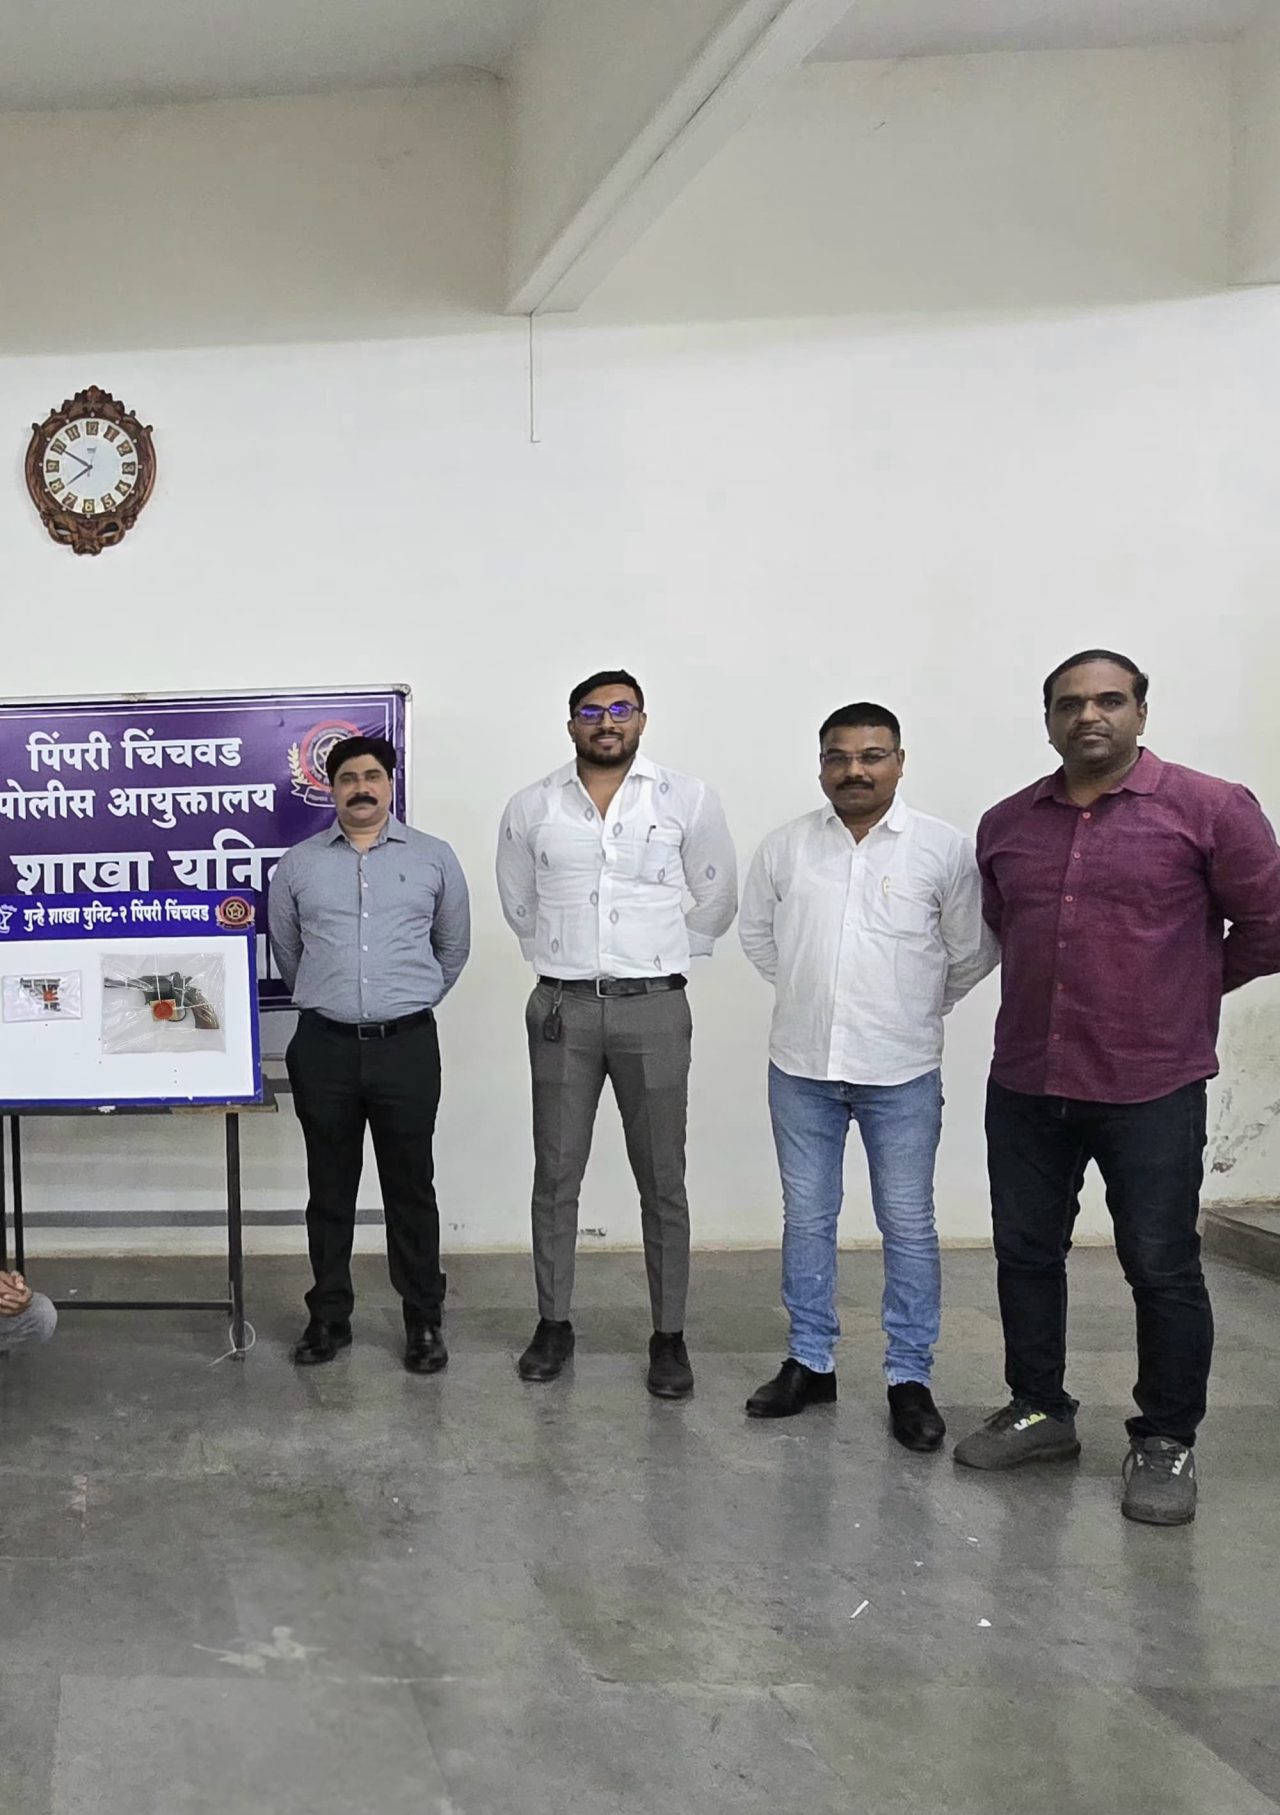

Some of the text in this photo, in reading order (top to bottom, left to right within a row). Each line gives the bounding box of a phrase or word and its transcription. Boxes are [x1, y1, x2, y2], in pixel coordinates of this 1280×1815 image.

[84, 501, 93, 512] 6
[25, 728, 242, 772] पिंपरी चिंचवड
[107, 784, 277, 829] आयुक्तालय
[9, 852, 154, 896] शाखा
[23, 902, 45, 932] गुन्हे
[47, 907, 80, 926] शाखा
[130, 899, 162, 922] पिंपरी
[165, 898, 210, 921] चिंचवड
